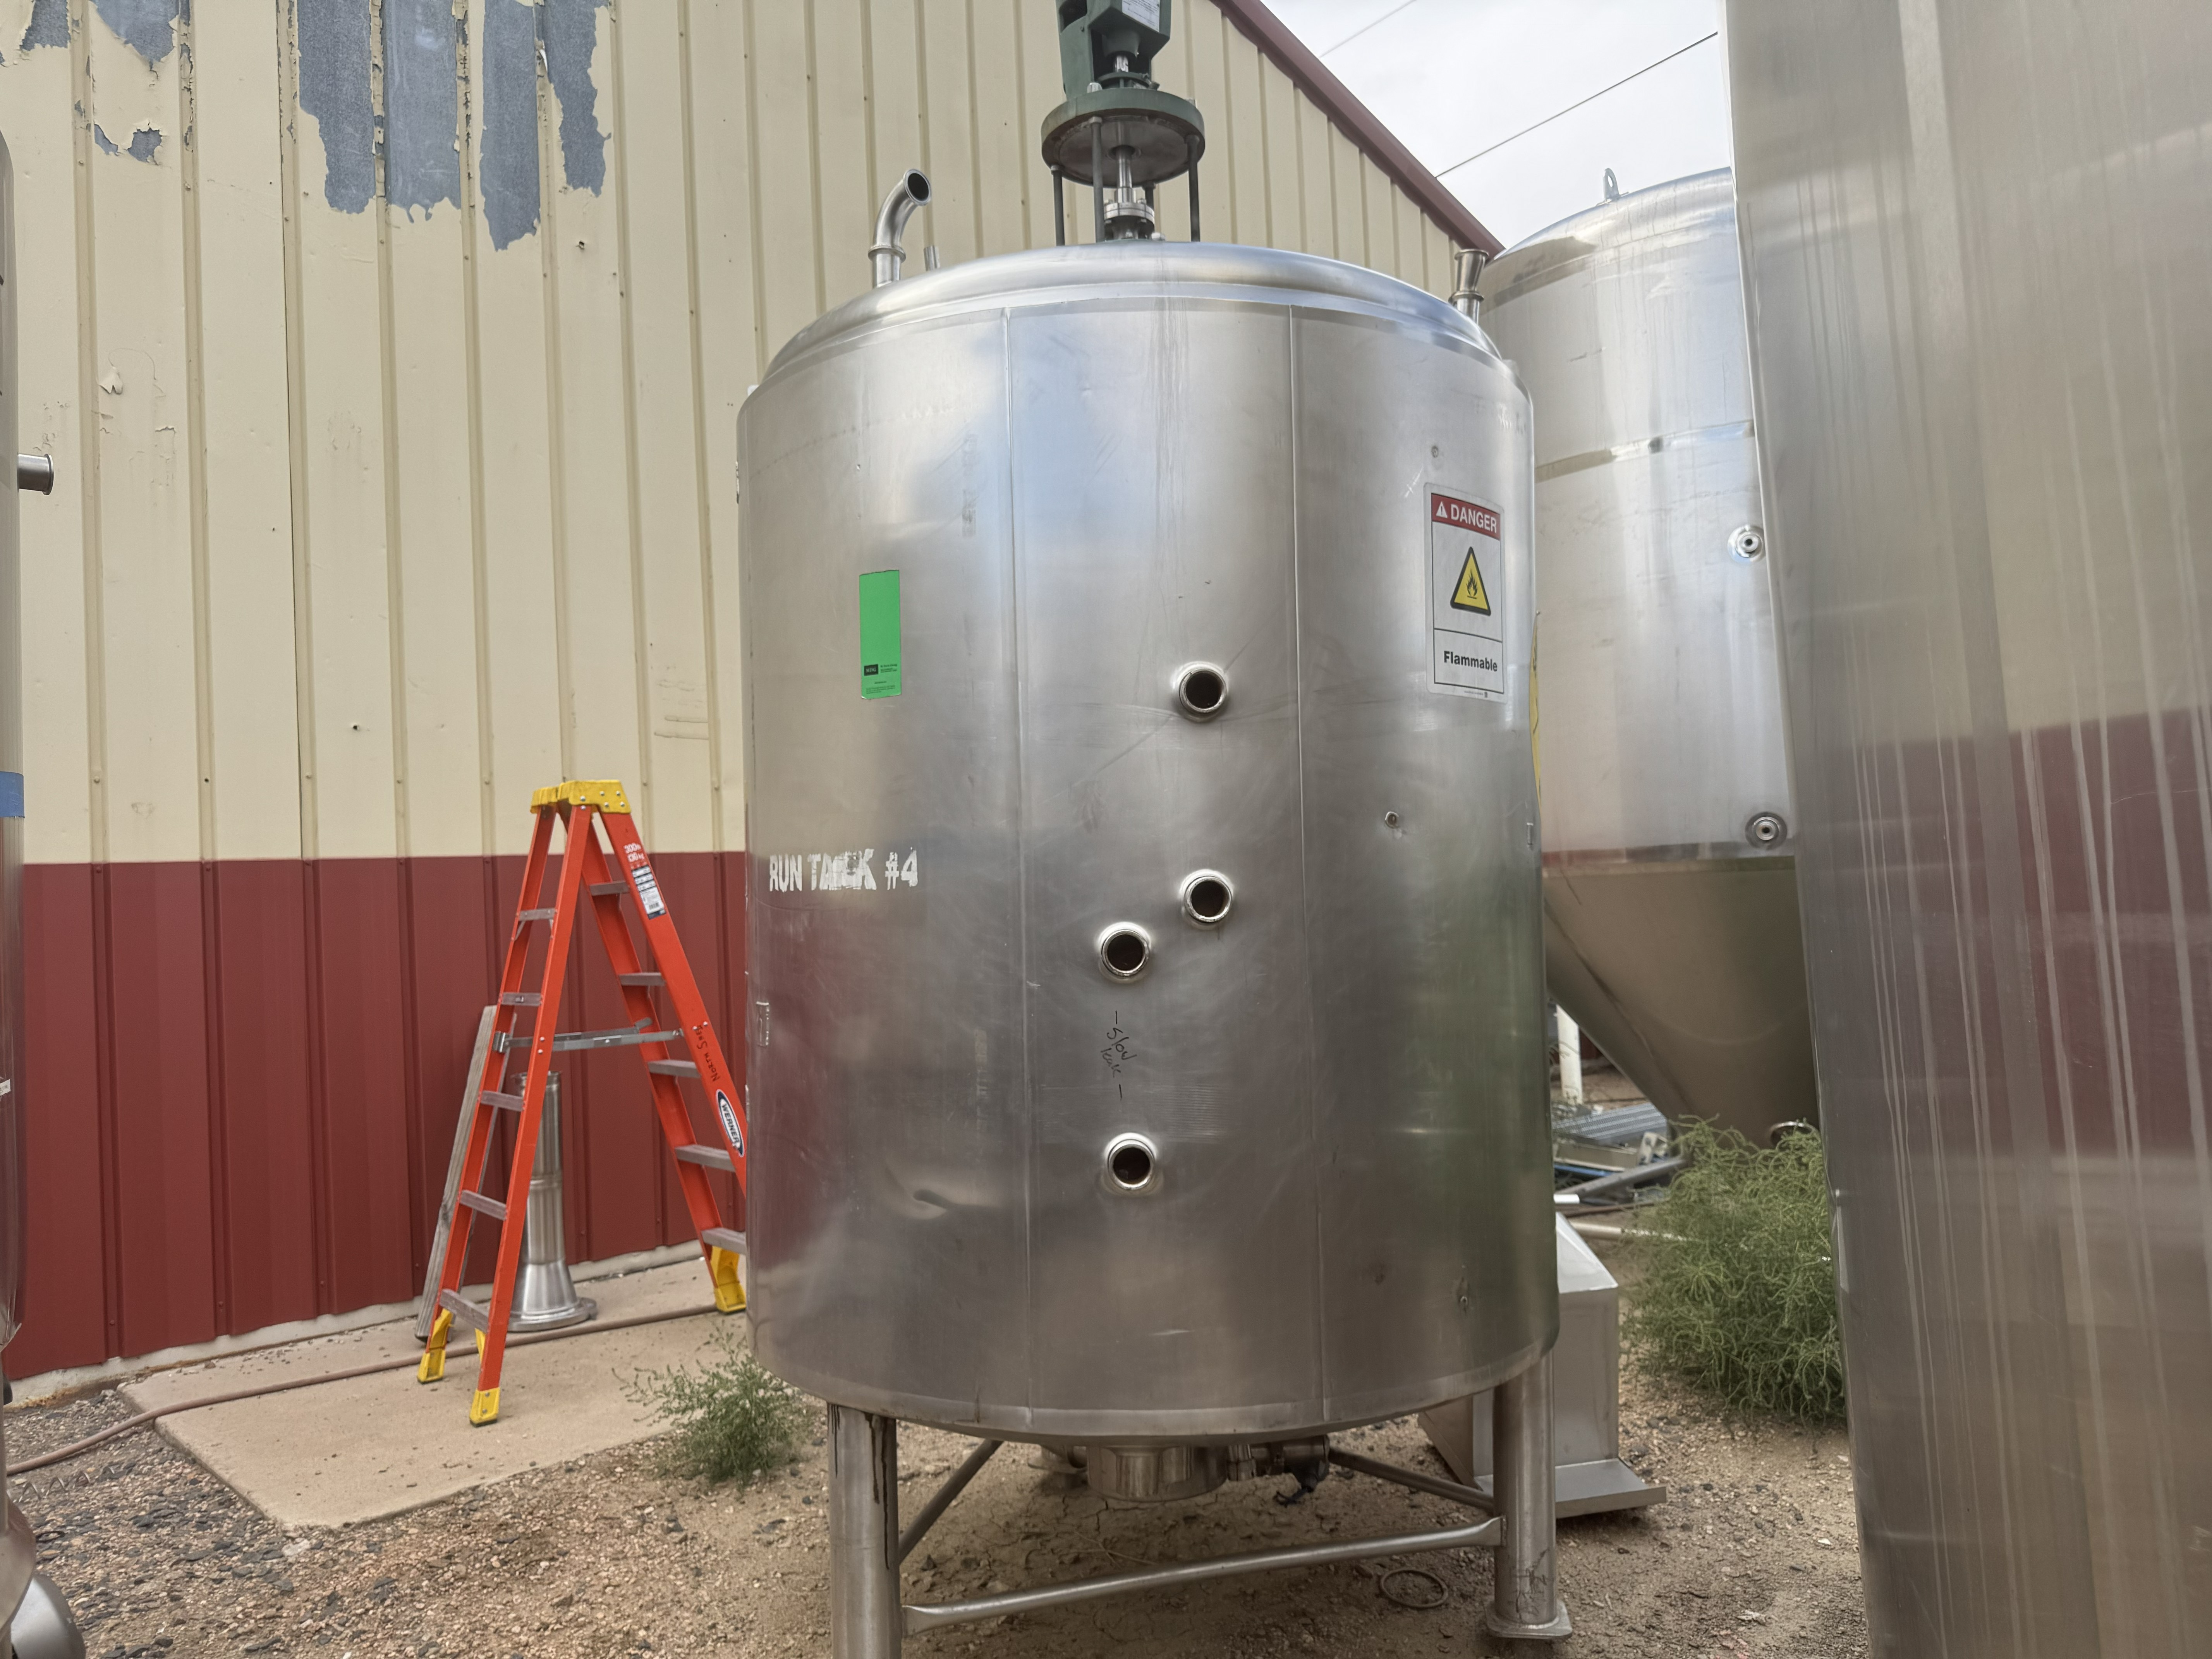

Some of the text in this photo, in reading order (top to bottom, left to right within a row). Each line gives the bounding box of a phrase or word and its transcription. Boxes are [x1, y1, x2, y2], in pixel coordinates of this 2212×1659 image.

[1450, 504, 1497, 534] DANGER
[1444, 651, 1498, 672] Flammable
[769, 848, 918, 893] RUN TAK #4
[722, 1103, 740, 1143] WERNER
